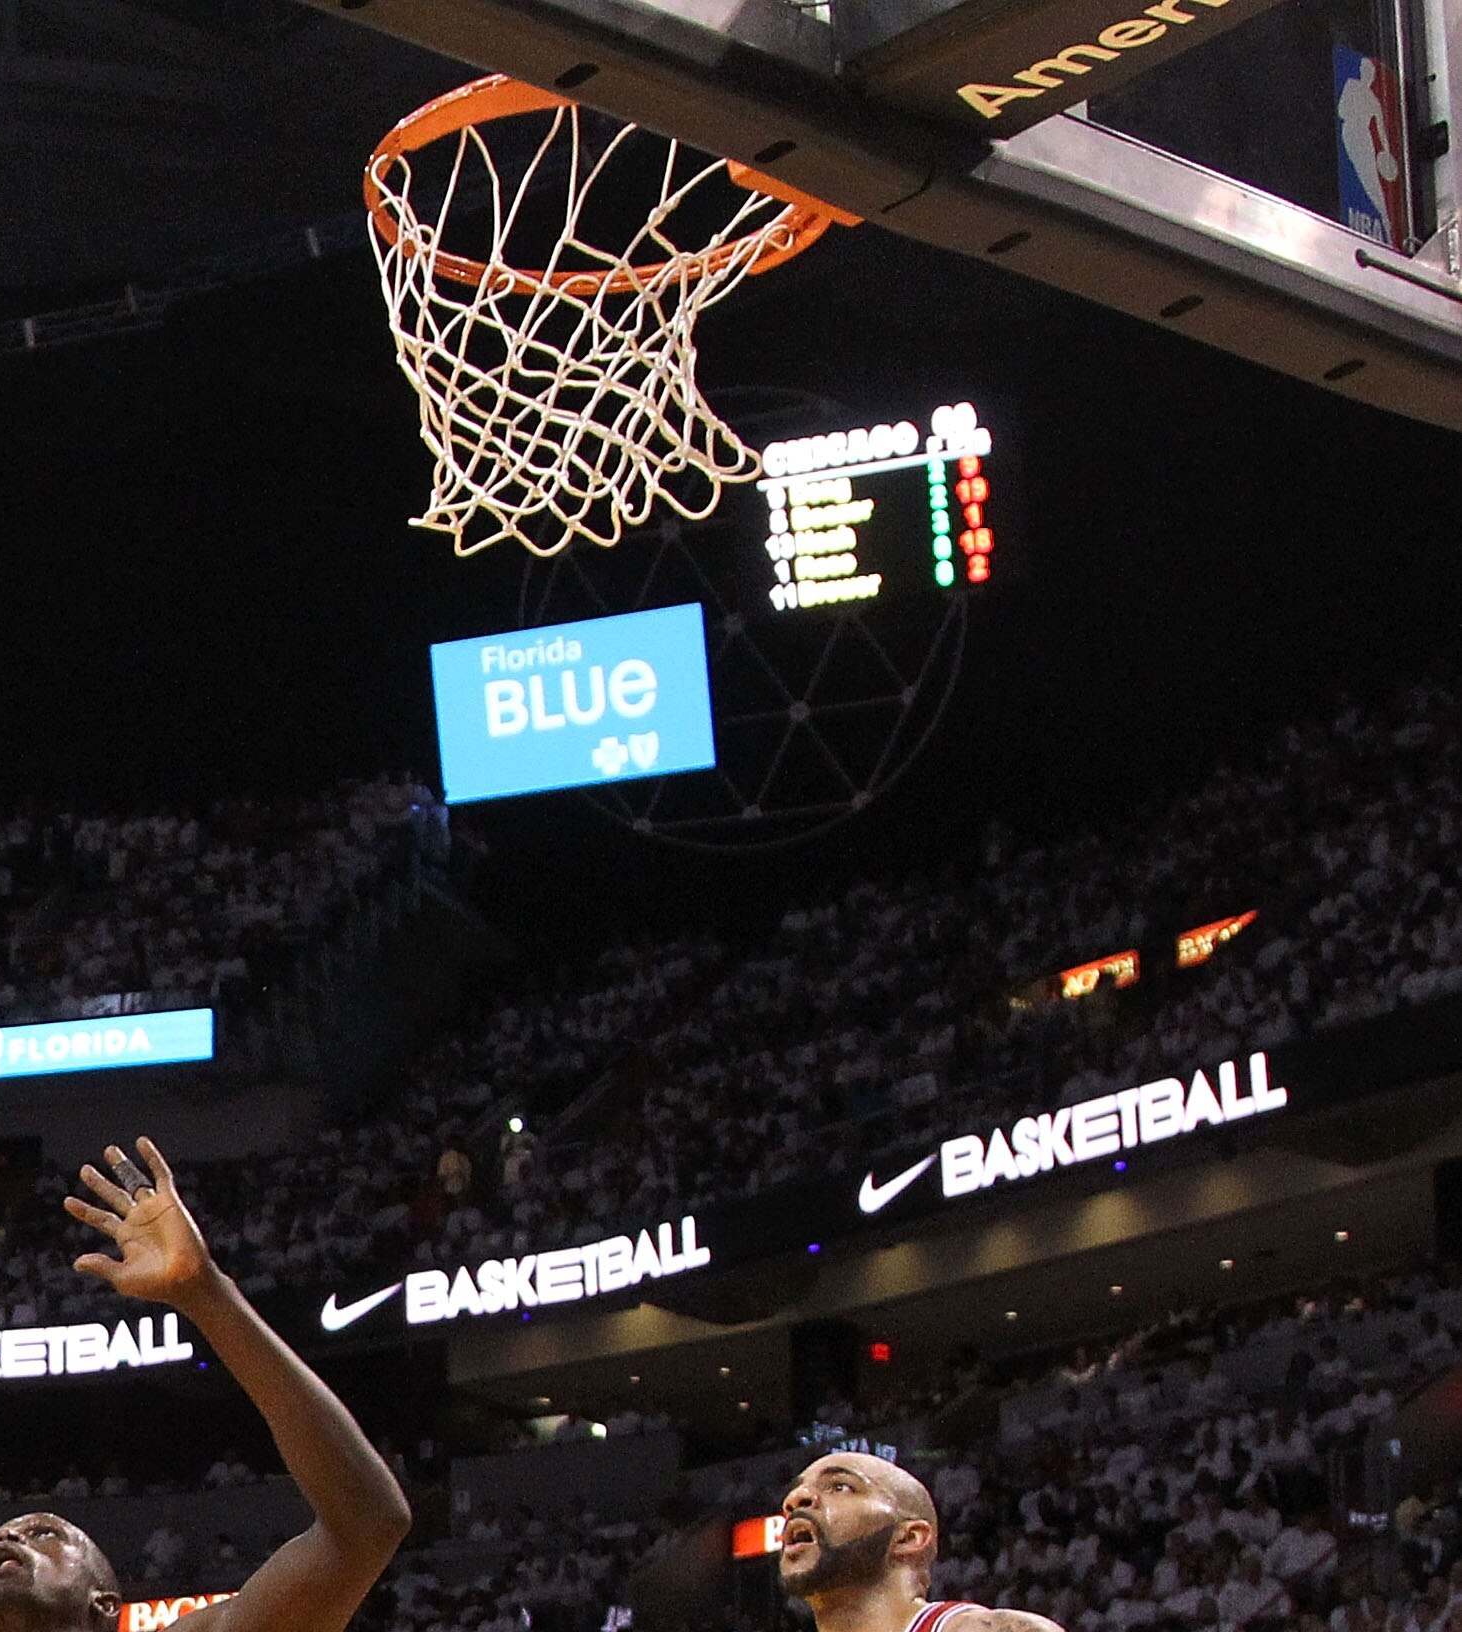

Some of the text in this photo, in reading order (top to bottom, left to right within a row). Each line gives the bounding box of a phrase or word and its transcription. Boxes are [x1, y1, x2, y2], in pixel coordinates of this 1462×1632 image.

[956, 0, 1229, 118] Amer
[481, 635, 583, 674] Florida
[6, 1028, 152, 1064] FLORIDA
[939, 1050, 1288, 1198] BASKETBALL
[405, 1215, 711, 1325] BASKETBALL
